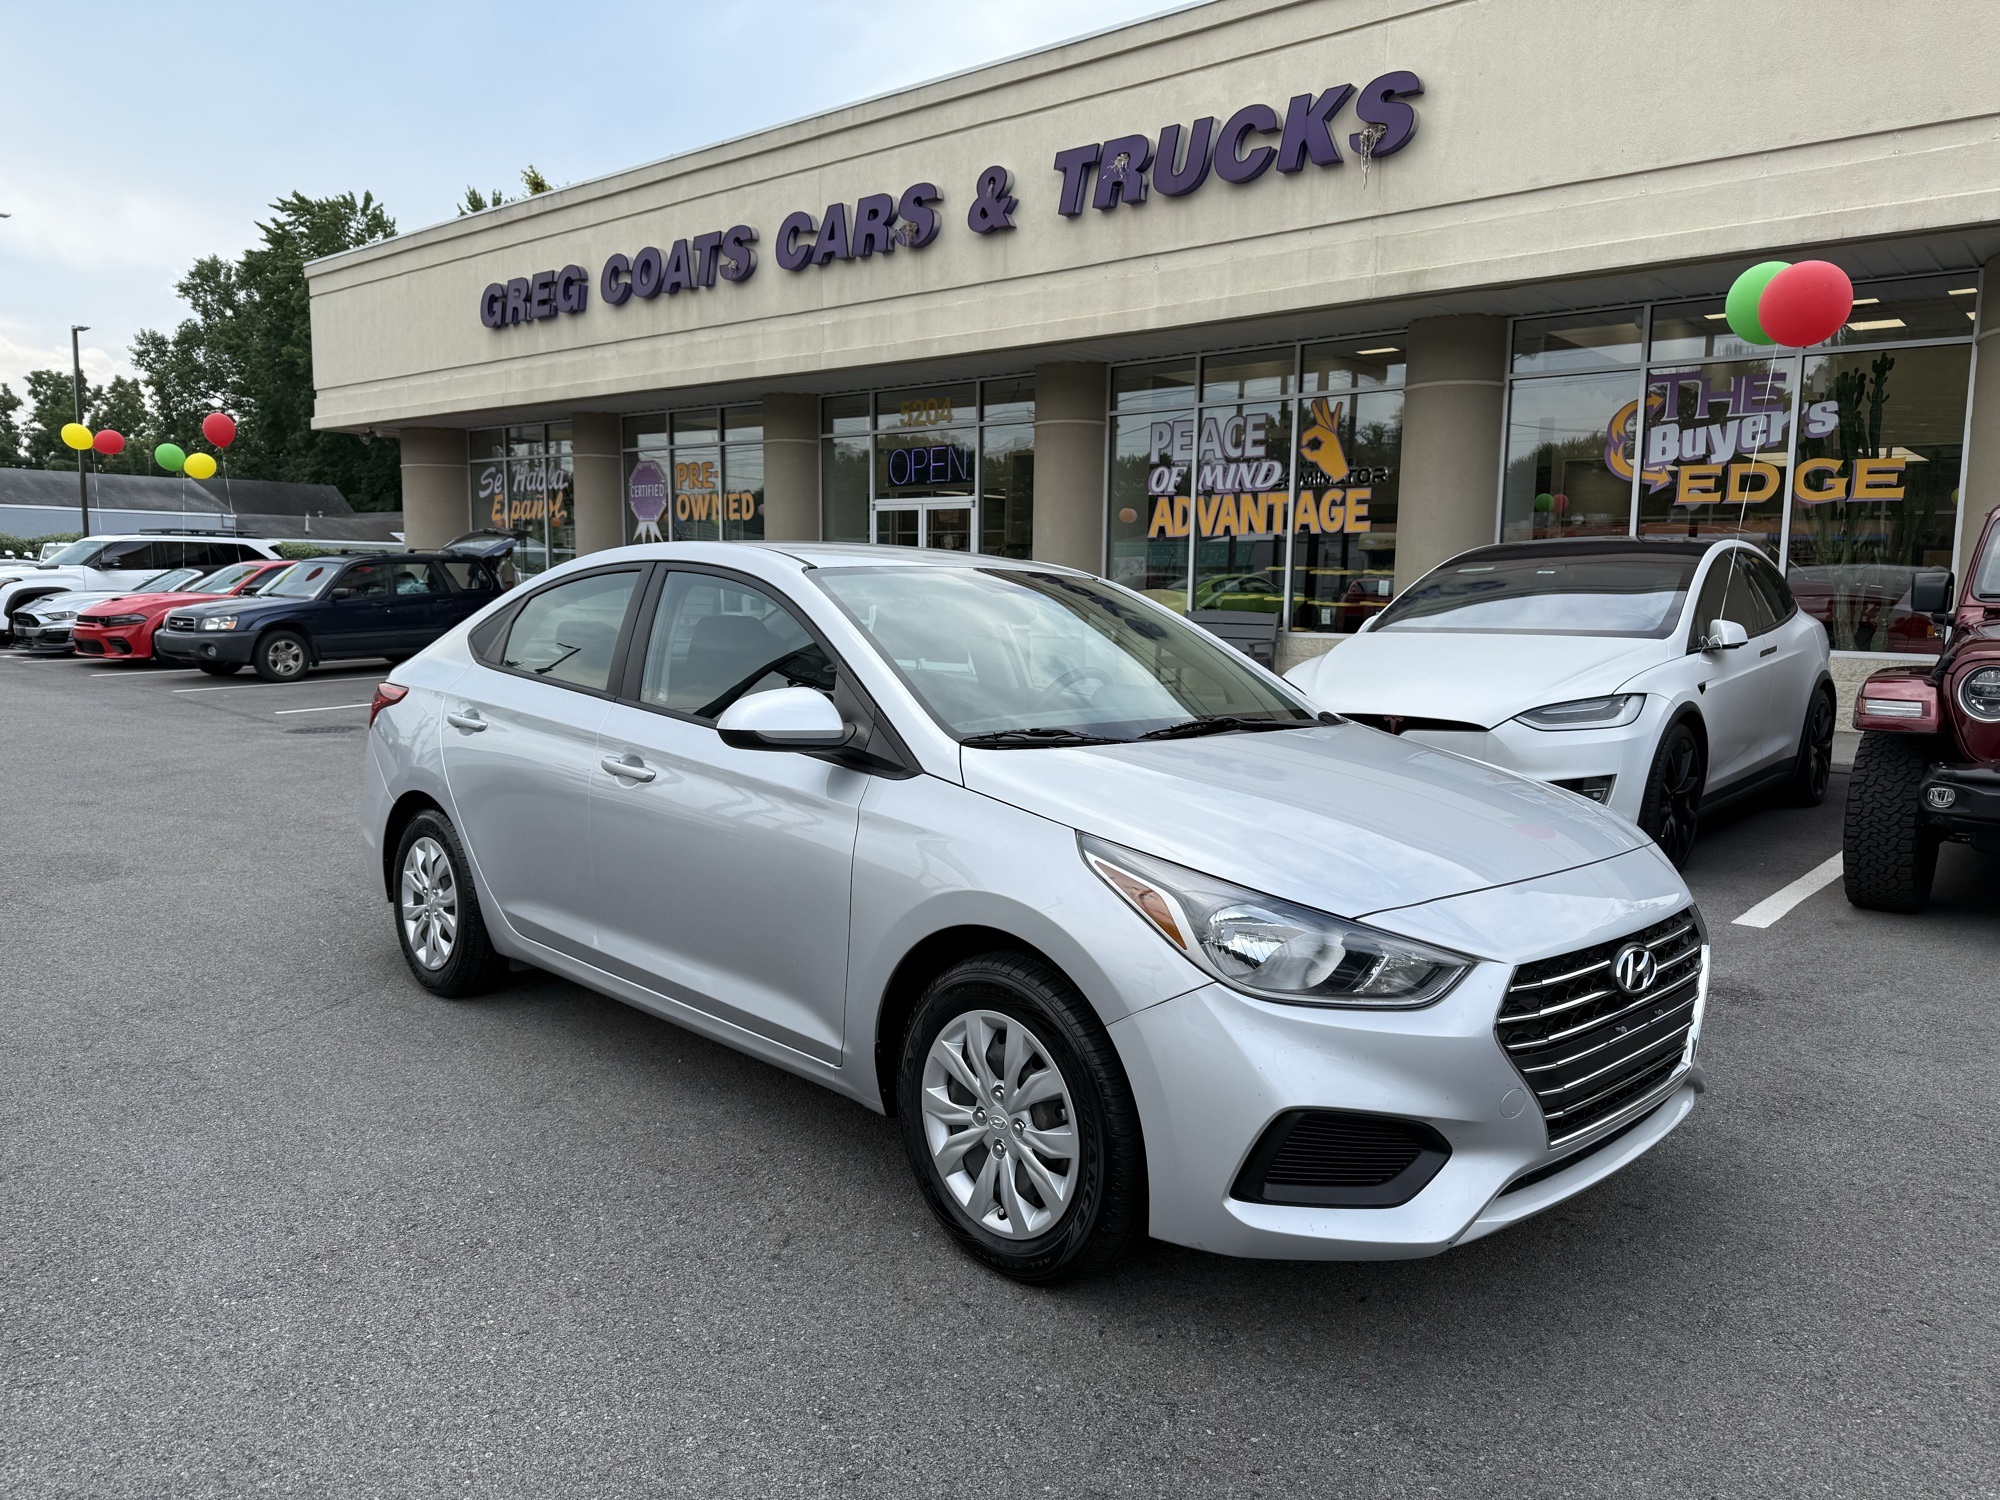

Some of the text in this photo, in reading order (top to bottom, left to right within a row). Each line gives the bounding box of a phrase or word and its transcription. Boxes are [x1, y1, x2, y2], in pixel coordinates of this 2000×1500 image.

[480, 70, 1425, 329] GREG COATS CARS & TRUCKS
[899, 397, 953, 428] 5204
[1649, 372, 1787, 421] THE
[1150, 413, 1268, 465] PEACE
[1645, 400, 1840, 466] Buyer's
[479, 459, 569, 498] Se Habla
[675, 461, 719, 490] PRE-
[889, 445, 967, 485] OPEN
[1148, 459, 1283, 496] OF MIND
[1672, 456, 1907, 506] EDGE
[630, 483, 665, 499] CERTIFIED
[676, 491, 755, 522] OWNED
[1147, 487, 1372, 539] ADVANTAGE
